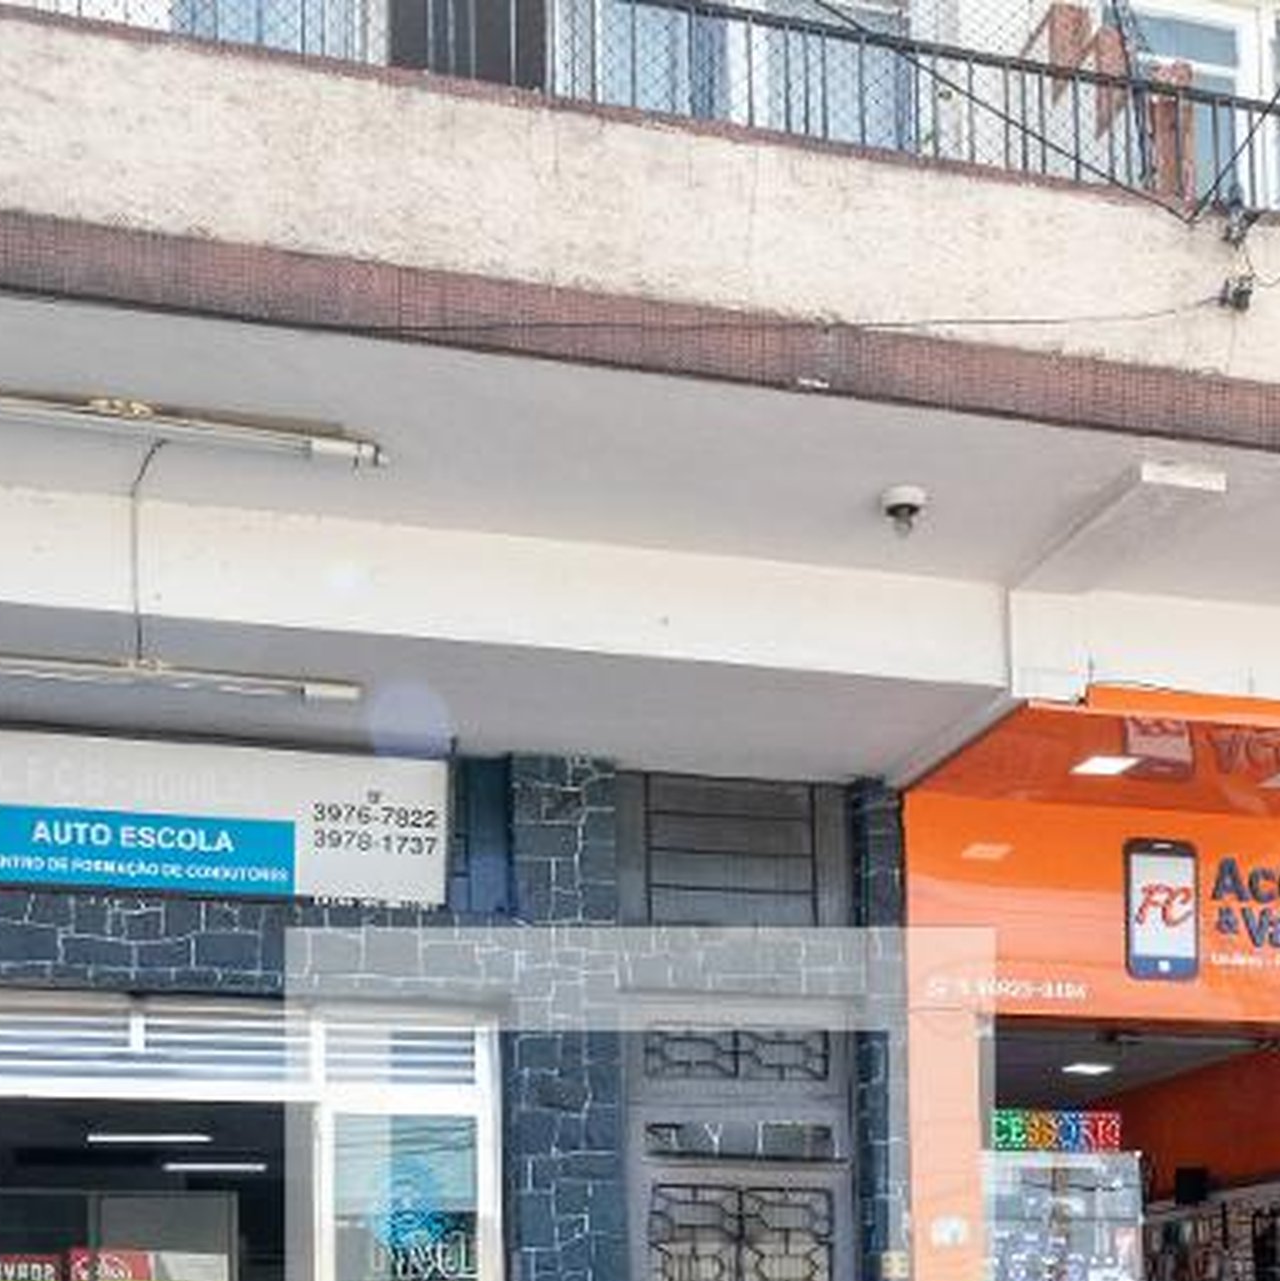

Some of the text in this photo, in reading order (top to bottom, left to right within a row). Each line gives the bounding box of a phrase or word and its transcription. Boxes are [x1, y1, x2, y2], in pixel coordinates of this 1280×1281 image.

[314, 803, 437, 829] 3976-7822
[31, 820, 234, 852] AUTO ESCOLA
[314, 830, 437, 855] 3978-1737
